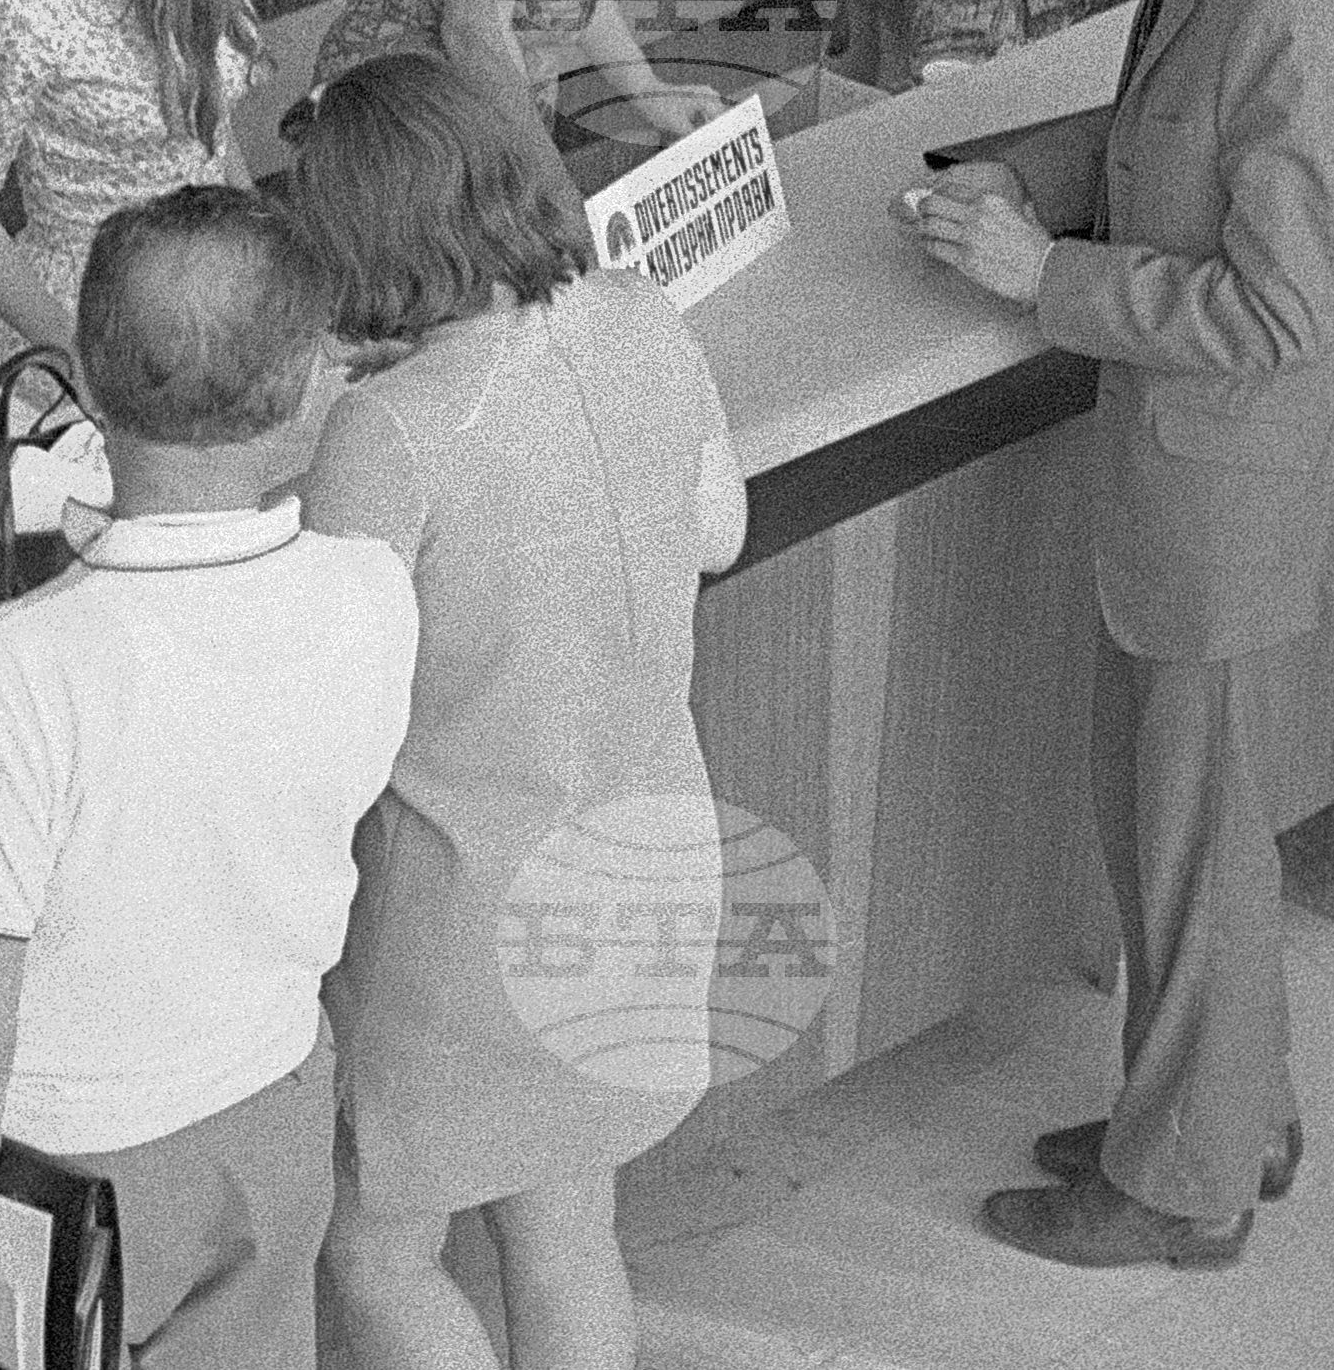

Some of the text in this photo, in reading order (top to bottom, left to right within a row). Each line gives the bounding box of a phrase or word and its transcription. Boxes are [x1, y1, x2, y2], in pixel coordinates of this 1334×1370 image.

[634, 128, 764, 243] DIVERTISSEMENTS
[646, 170, 775, 287] КУЛТУРНИ ПРОЯВИ
